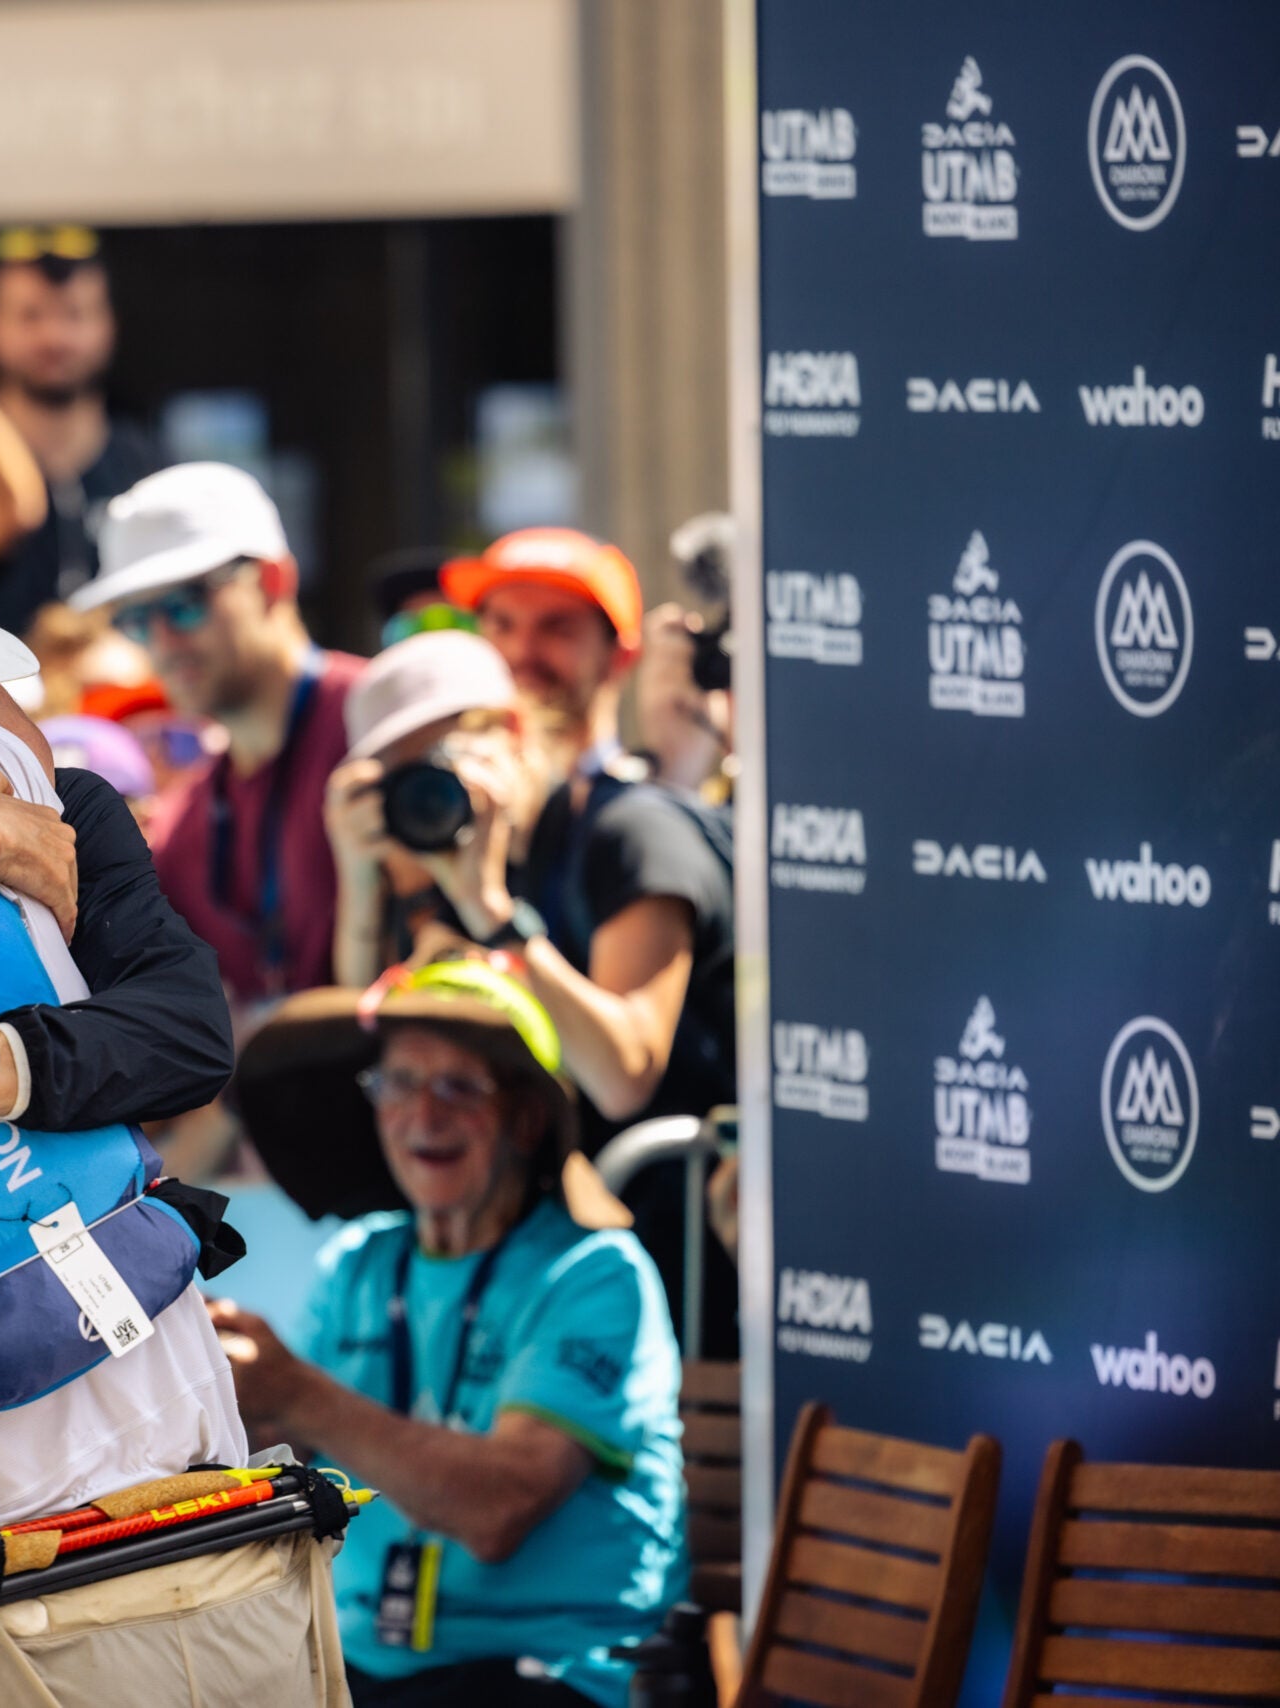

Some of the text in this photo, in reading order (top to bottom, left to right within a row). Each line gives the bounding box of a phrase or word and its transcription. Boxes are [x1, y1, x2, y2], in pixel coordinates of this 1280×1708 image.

[762, 108, 856, 160] UTMB
[922, 121, 1015, 148] DACIA
[922, 150, 1017, 202] UTMB
[765, 352, 861, 406] HOKA
[907, 378, 1040, 412] DACIA
[1079, 365, 1205, 427] wahoo
[767, 572, 862, 626] UTMB
[929, 595, 1022, 622] DACIA
[928, 624, 1024, 678] UTMB
[771, 804, 866, 865] HOKA
[913, 839, 1047, 883] DACIA
[1085, 842, 1211, 907] wahoo
[774, 1022, 868, 1083] UTMB
[934, 1057, 1028, 1091] DACIA
[934, 1087, 1030, 1146] UTMB
[778, 1267, 872, 1334] HOKA
[919, 1313, 1053, 1365] DACIA
[1090, 1330, 1216, 1399] wahoo
[150, 1490, 231, 1522] LEKI
